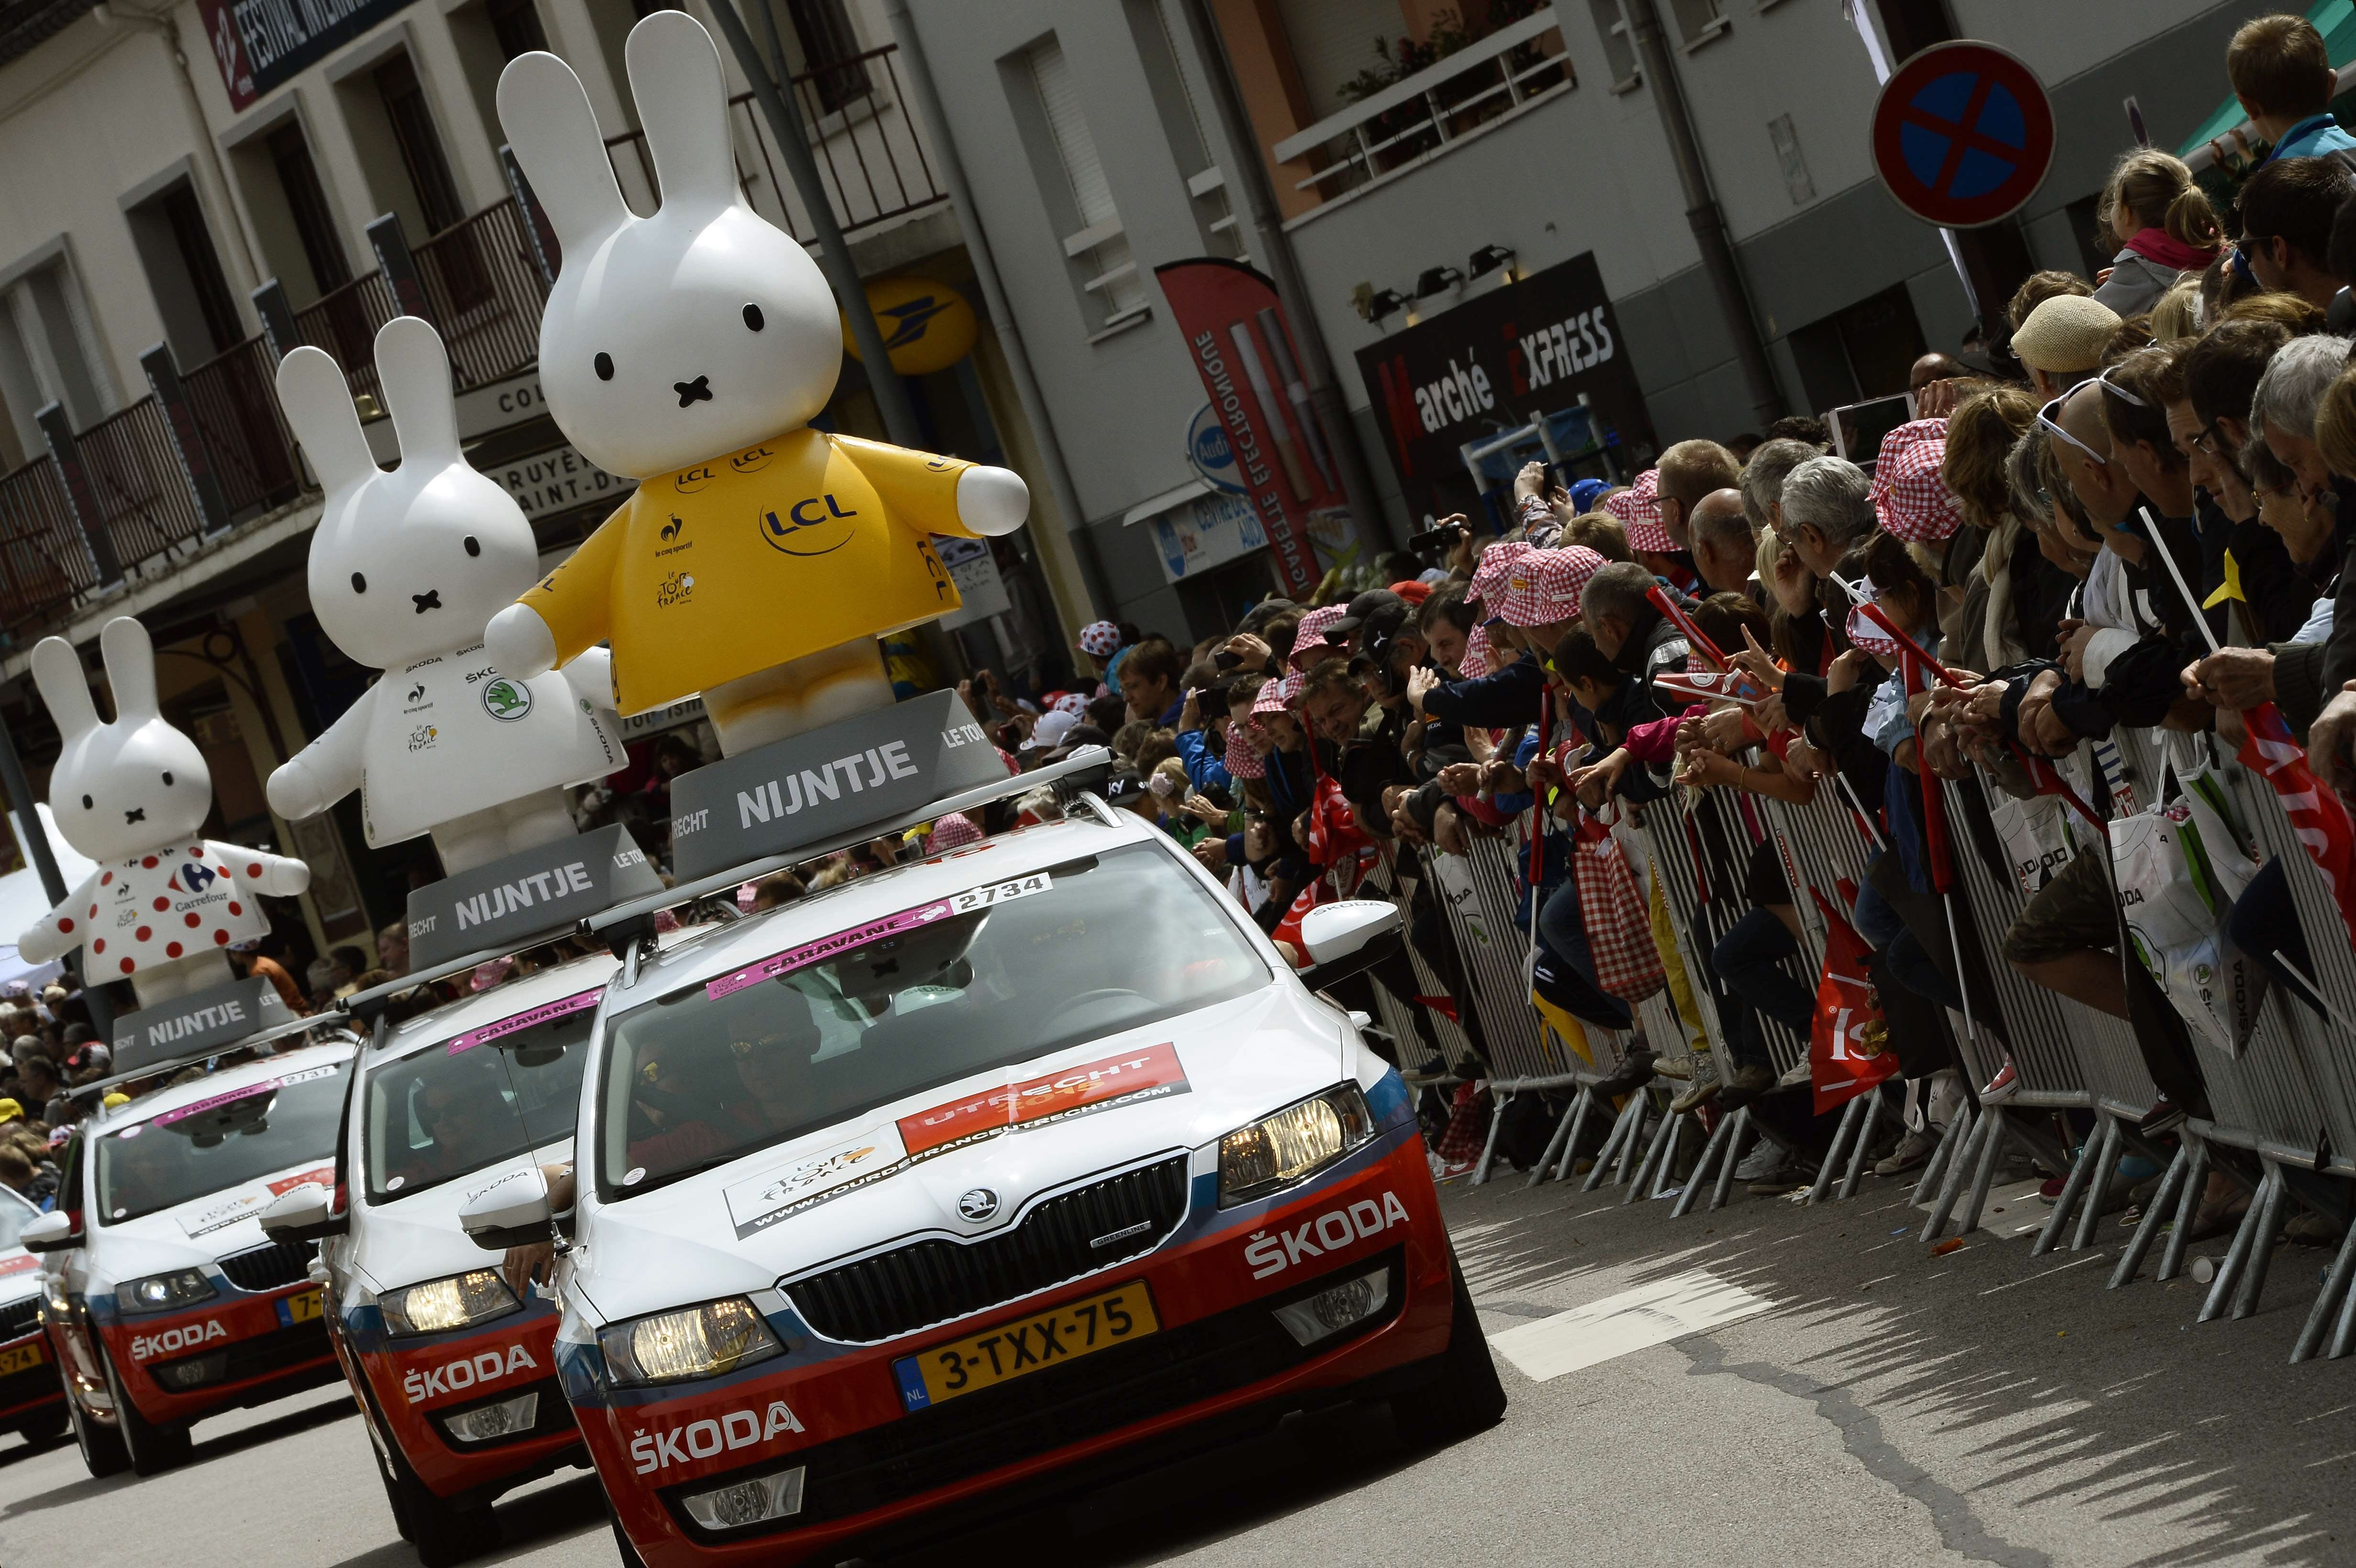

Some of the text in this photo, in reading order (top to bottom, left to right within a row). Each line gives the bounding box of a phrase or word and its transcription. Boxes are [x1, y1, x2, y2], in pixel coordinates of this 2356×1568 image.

[677, 467, 716, 485] LCL
[732, 447, 774, 467] LCL
[765, 494, 858, 536] LCL
[655, 540, 692, 558] le coq sportif
[916, 541, 947, 600] LCL
[405, 657, 443, 674] ŠKODA
[589, 718, 614, 765] ŠKODA
[737, 740, 918, 829] NIJNTJE
[941, 729, 961, 749] LE
[959, 722, 988, 745] TOU
[175, 893, 229, 912] Carrefour
[455, 861, 593, 931] NIJNTJE
[612, 853, 630, 869] LE
[959, 877, 1044, 910] 2734
[1313, 902, 1383, 916] ŠKODA
[763, 919, 902, 974] CARAVANE
[2234, 959, 2248, 1031] ŠKODA
[148, 1001, 246, 1046] NIJNTJE
[475, 1000, 579, 1041] CARAVANE
[286, 1067, 330, 1084] 2737
[925, 1056, 1150, 1126] UTRECHT
[997, 1078, 1104, 1113] 2015
[182, 1088, 256, 1115] CARAVANE
[754, 1086, 1171, 1227] WWW.TOURDEFRANCEUTRECHT.COM
[467, 1171, 528, 1205] ŠKODA
[1097, 1224, 1146, 1245] GREENLINE
[1243, 1191, 1410, 1281] ŠKODA
[131, 1318, 227, 1361] ŠKODA
[939, 1296, 1133, 1390] 3-TXX-75
[404, 1344, 537, 1404] ŠKODA
[906, 1388, 926, 1403] NL
[630, 1399, 806, 1476] ŠKODA
